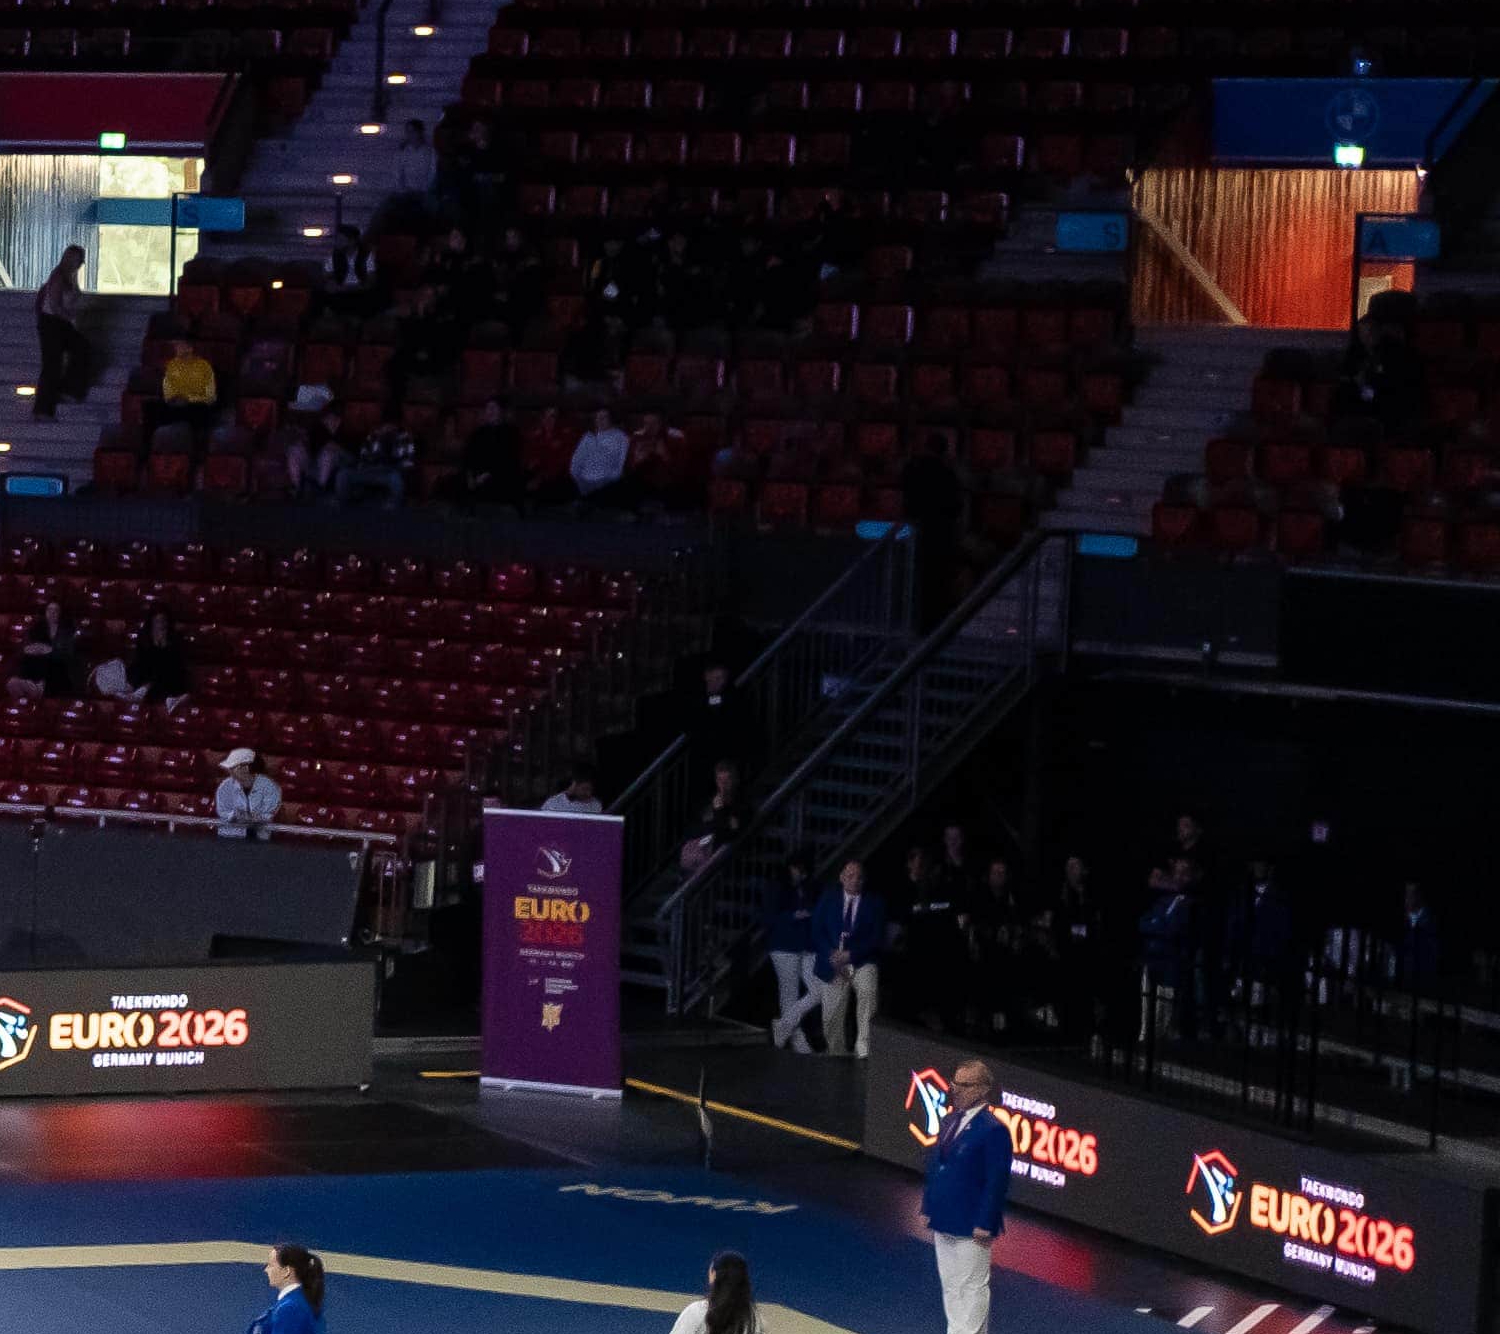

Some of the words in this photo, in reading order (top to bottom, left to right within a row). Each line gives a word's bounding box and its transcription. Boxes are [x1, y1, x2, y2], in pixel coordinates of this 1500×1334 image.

[182, 205, 200, 224] S
[513, 895, 591, 924] EURO
[111, 994, 188, 1009] TAEKWONDO
[50, 1012, 154, 1049] EURO
[157, 1009, 248, 1047] 2026
[92, 1053, 153, 1067] GERMANY
[156, 1051, 204, 1065] MUNICH
[1031, 1119, 1098, 1177] 2026
[1251, 1183, 1335, 1245] EURO
[1337, 1208, 1415, 1272] 2026
